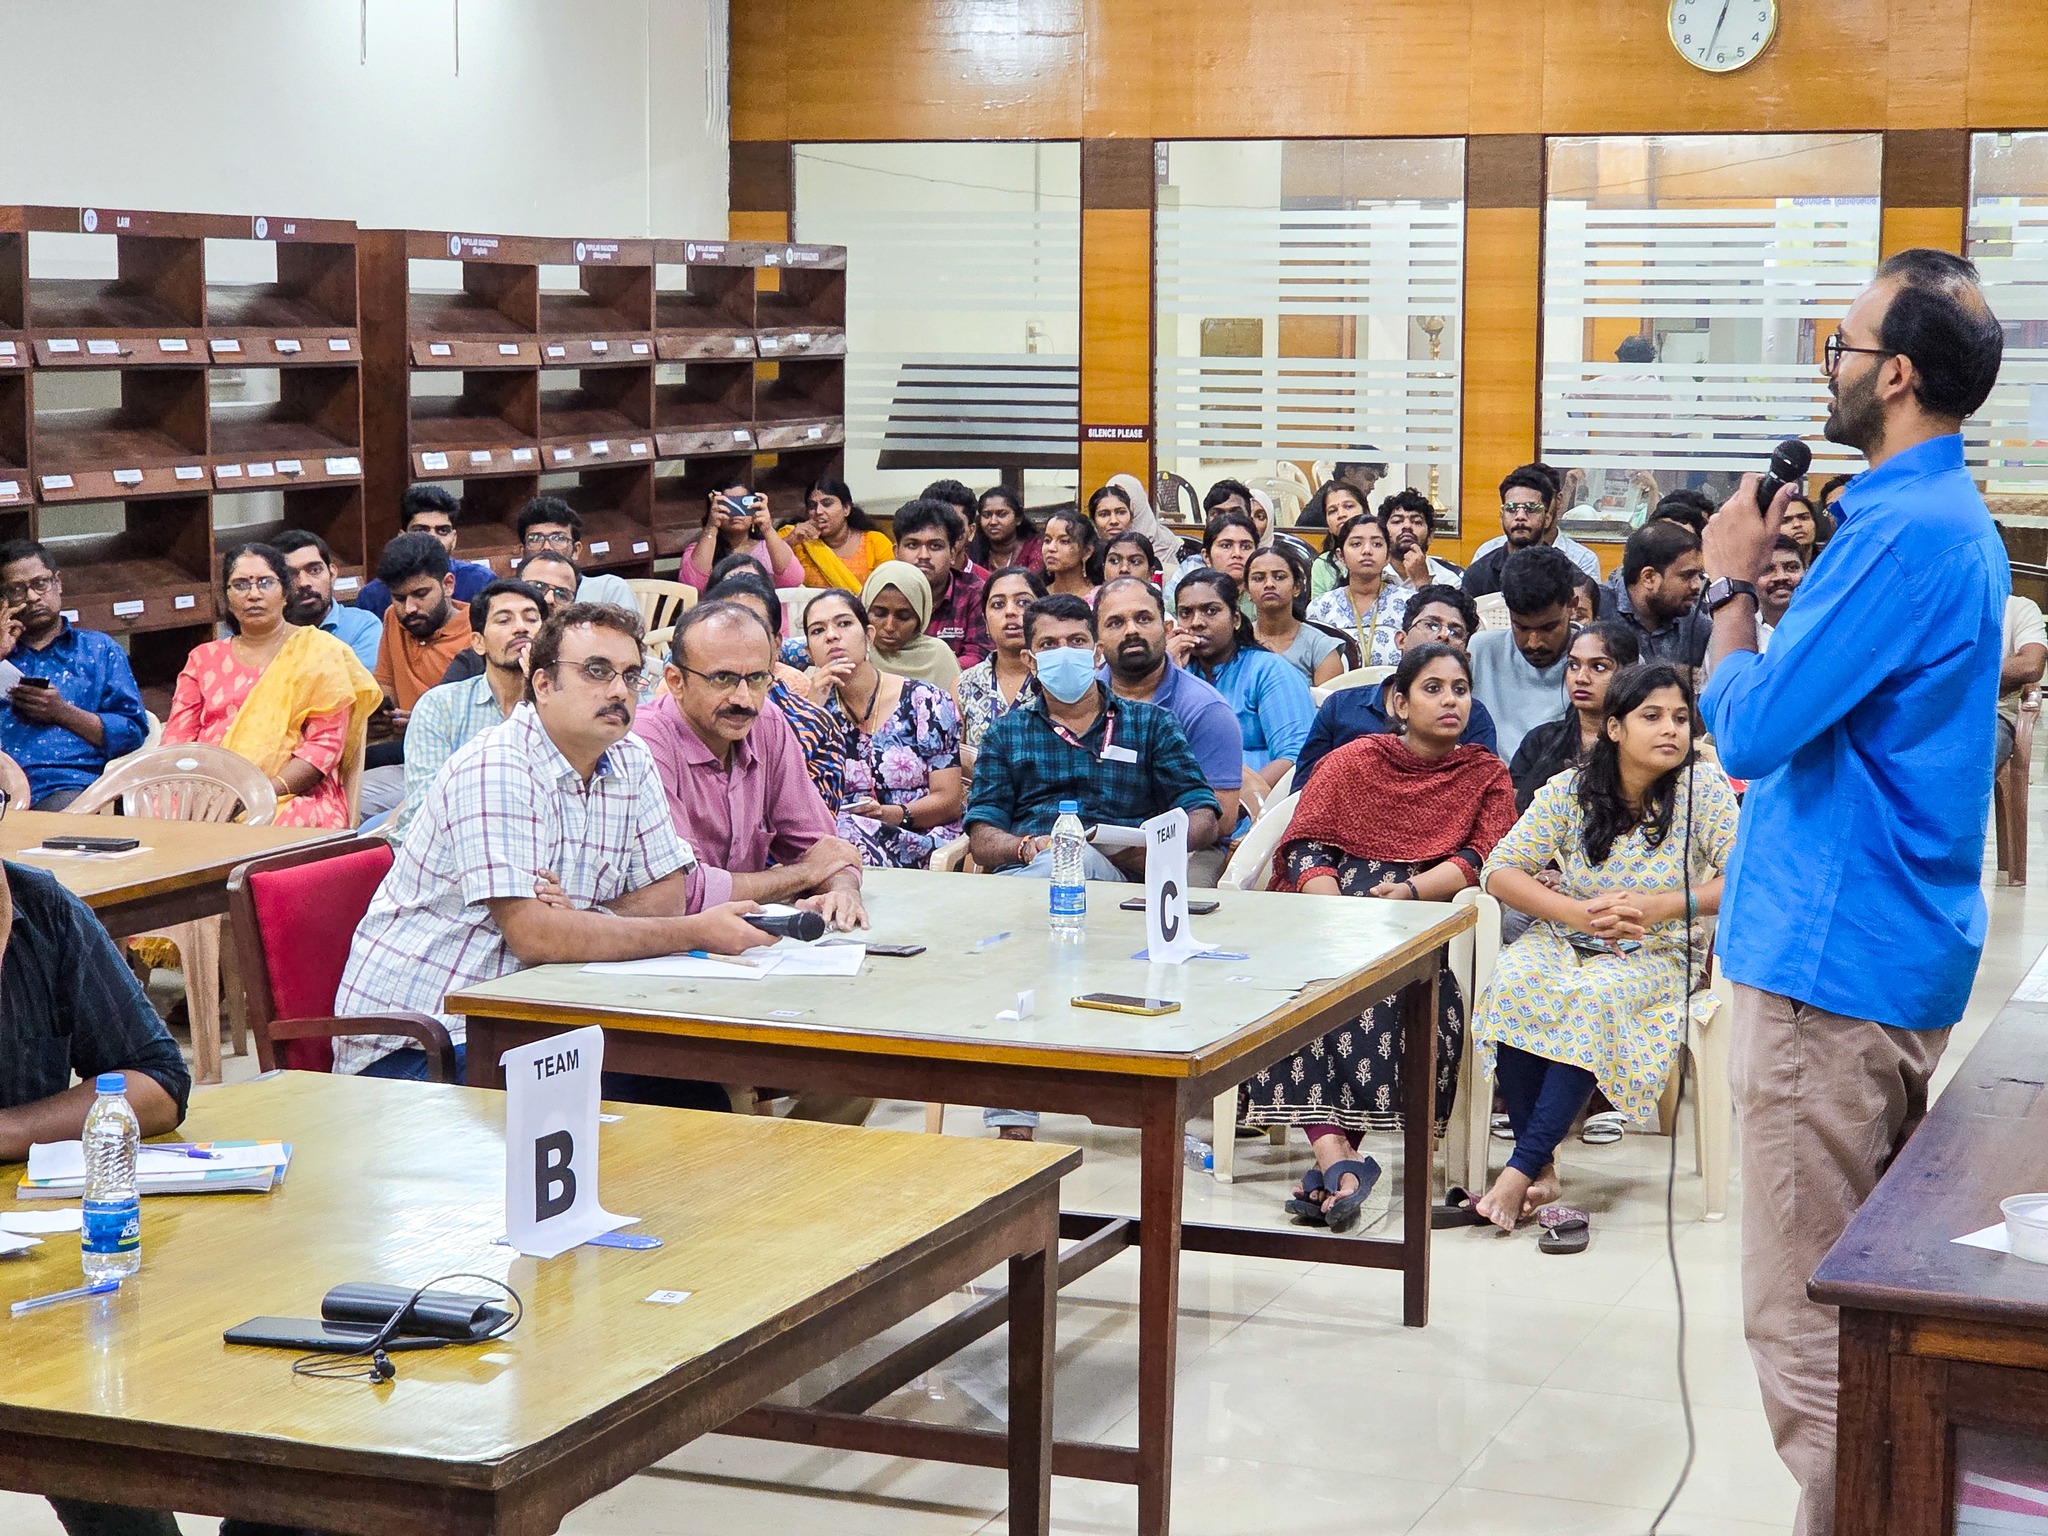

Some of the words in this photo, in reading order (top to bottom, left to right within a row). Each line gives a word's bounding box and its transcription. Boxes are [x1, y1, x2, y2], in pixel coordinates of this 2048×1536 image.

[1678, 14, 1687, 25] 9
[1758, 12, 1767, 22] 3
[1683, 34, 1692, 44] 8
[1751, 32, 1760, 42] 4
[1698, 48, 1706, 58] 7
[1737, 47, 1745, 57] 5
[1716, 53, 1725, 63] 6
[116, 216, 130, 228] LAW
[1088, 428, 1116, 438] SILENCE
[1117, 428, 1143, 438] PLEASE
[1156, 823, 1176, 845] TEAM
[1160, 880, 1179, 943] C
[533, 1048, 580, 1081] TEAM
[535, 1129, 577, 1224] B
